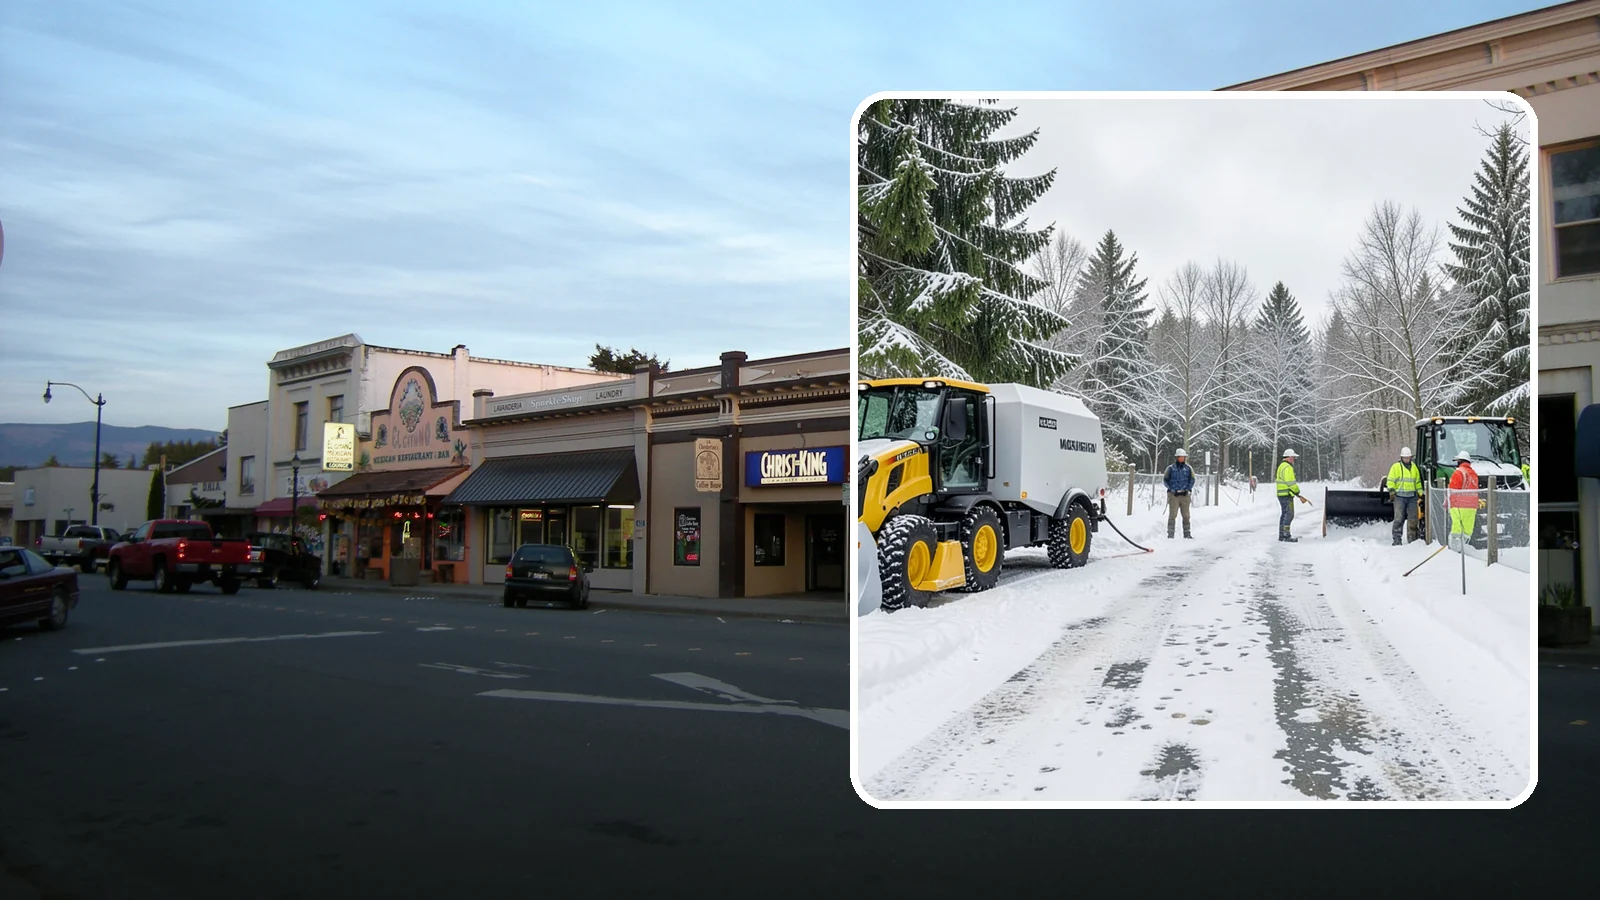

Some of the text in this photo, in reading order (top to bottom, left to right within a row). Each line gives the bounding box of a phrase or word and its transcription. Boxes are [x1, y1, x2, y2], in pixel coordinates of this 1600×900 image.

[530, 394, 582, 408] Sparkle Shop
[596, 389, 623, 399] LAUNDRY
[493, 402, 523, 412] LAVANDERIA
[374, 450, 450, 464] MEXICAN RESTAURANT BAR
[761, 450, 827, 478] CHRIST KING
